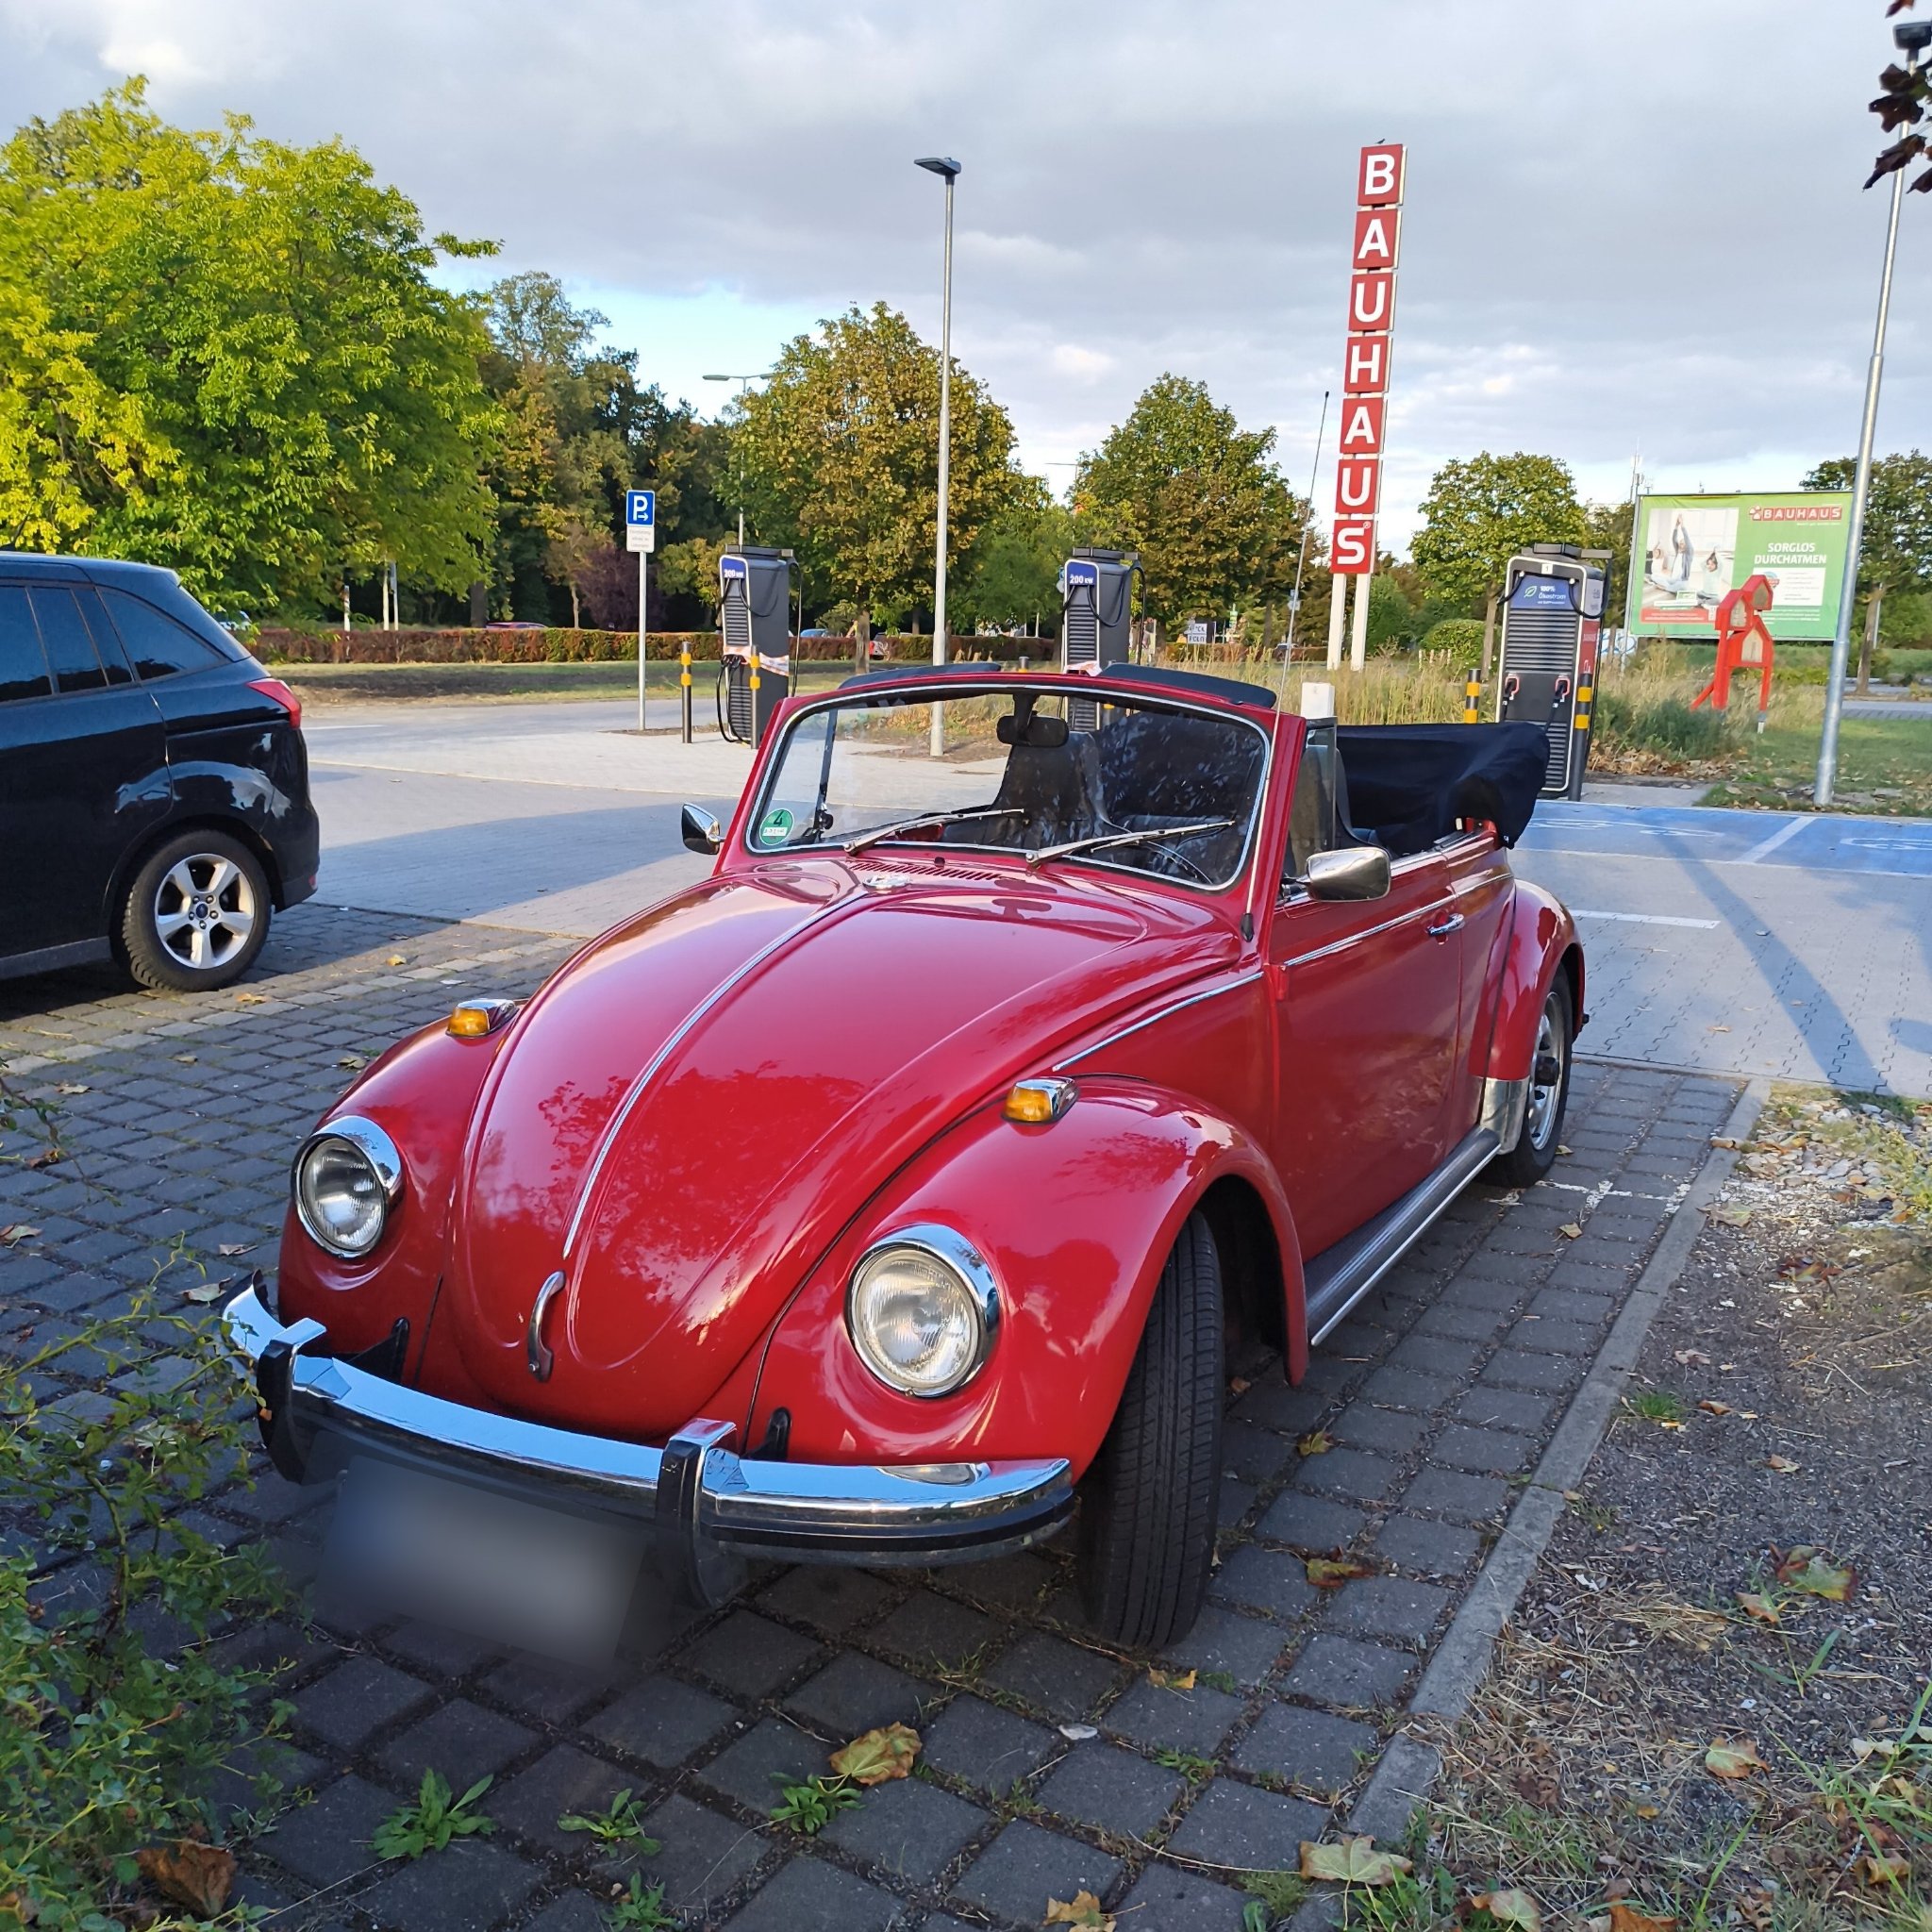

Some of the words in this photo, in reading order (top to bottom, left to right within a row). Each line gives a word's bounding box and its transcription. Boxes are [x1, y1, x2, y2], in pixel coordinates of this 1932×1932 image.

[1337, 154, 1395, 565] BAUHAUS
[633, 495, 648, 521] P
[1763, 508, 1840, 519] BAUHAUS
[1767, 542, 1816, 553] SORGLOS
[1754, 554, 1827, 564] DURCHATMEN
[724, 569, 736, 577] 200
[1069, 574, 1084, 584] 200
[773, 809, 785, 826] 4
